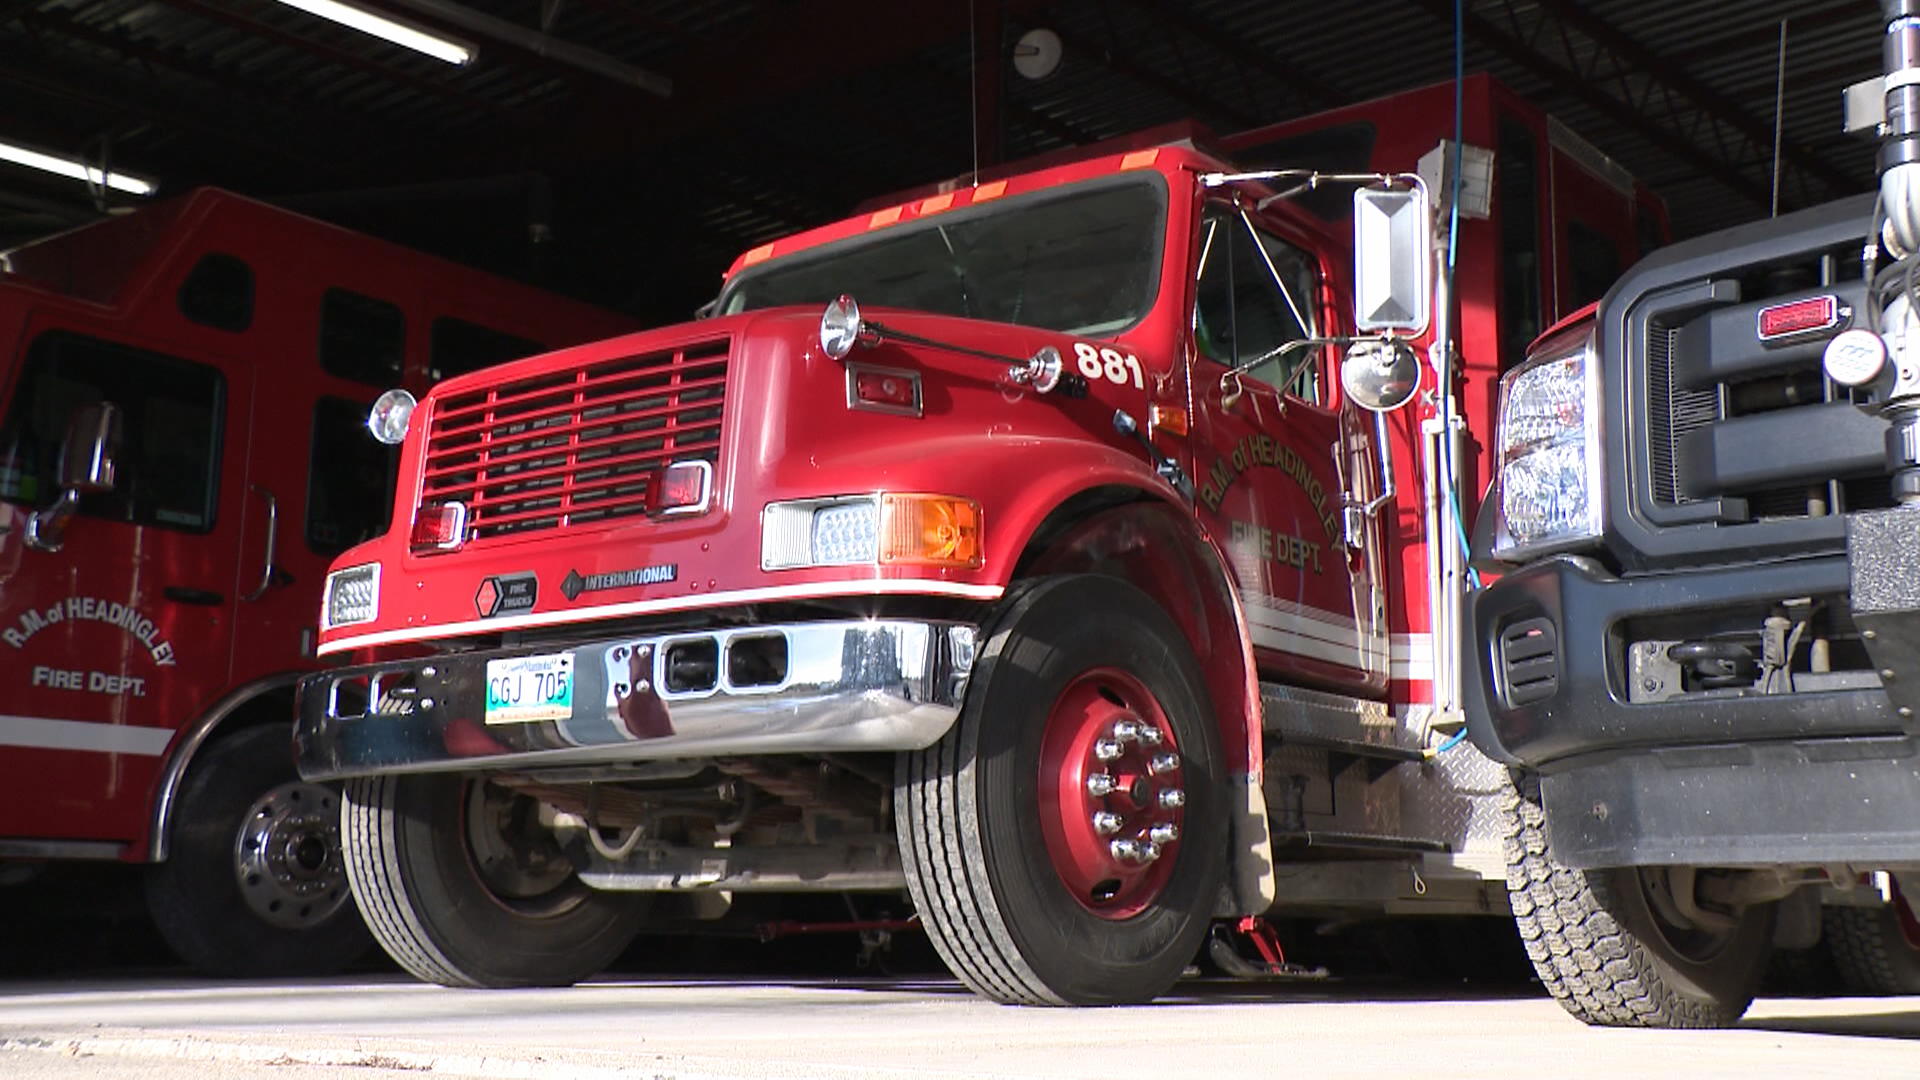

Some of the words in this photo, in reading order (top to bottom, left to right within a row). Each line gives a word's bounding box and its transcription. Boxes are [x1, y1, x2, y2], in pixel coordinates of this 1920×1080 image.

[1074, 342, 1144, 390] 881
[1232, 438, 1248, 472] of
[1232, 520, 1273, 561] FIRE
[1277, 532, 1323, 575] DEPT.
[585, 564, 675, 589] INTERNATIONAL
[2, 608, 48, 648] R.M.
[47, 602, 64, 624] of
[66, 597, 176, 667] HEADINGLEY
[33, 665, 83, 691] FIRE
[88, 671, 145, 697] DEPT.
[490, 674, 522, 704] CGJ
[535, 671, 567, 702] 705
